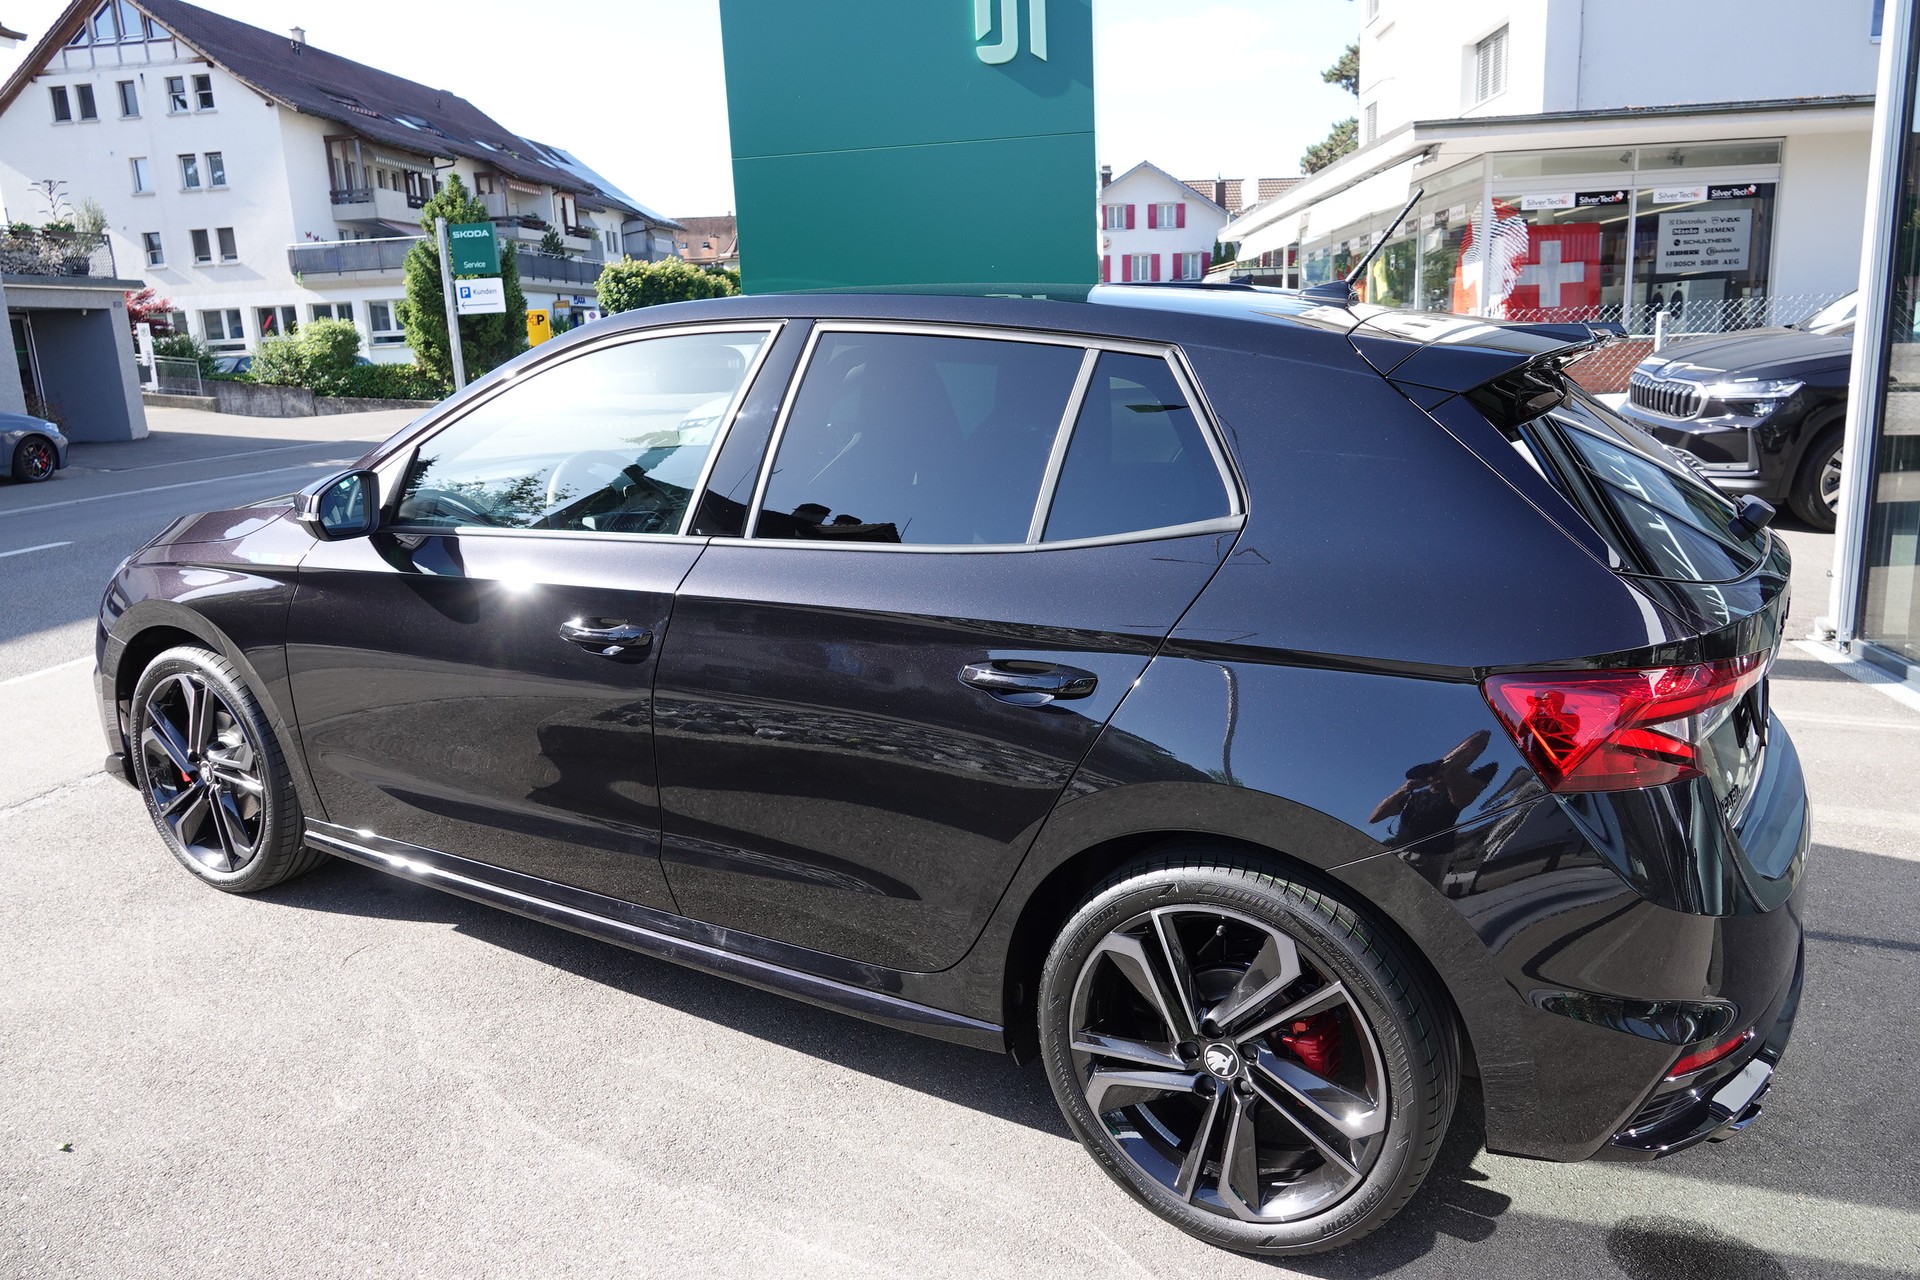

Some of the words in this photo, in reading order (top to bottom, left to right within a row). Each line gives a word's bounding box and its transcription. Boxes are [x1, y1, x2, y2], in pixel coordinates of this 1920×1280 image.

[1704, 226, 1735, 234] SIEMENS
[1683, 237, 1732, 245] SCHULTHESS
[463, 261, 486, 269] Service
[461, 287, 470, 297] P
[472, 287, 497, 295] Kunden
